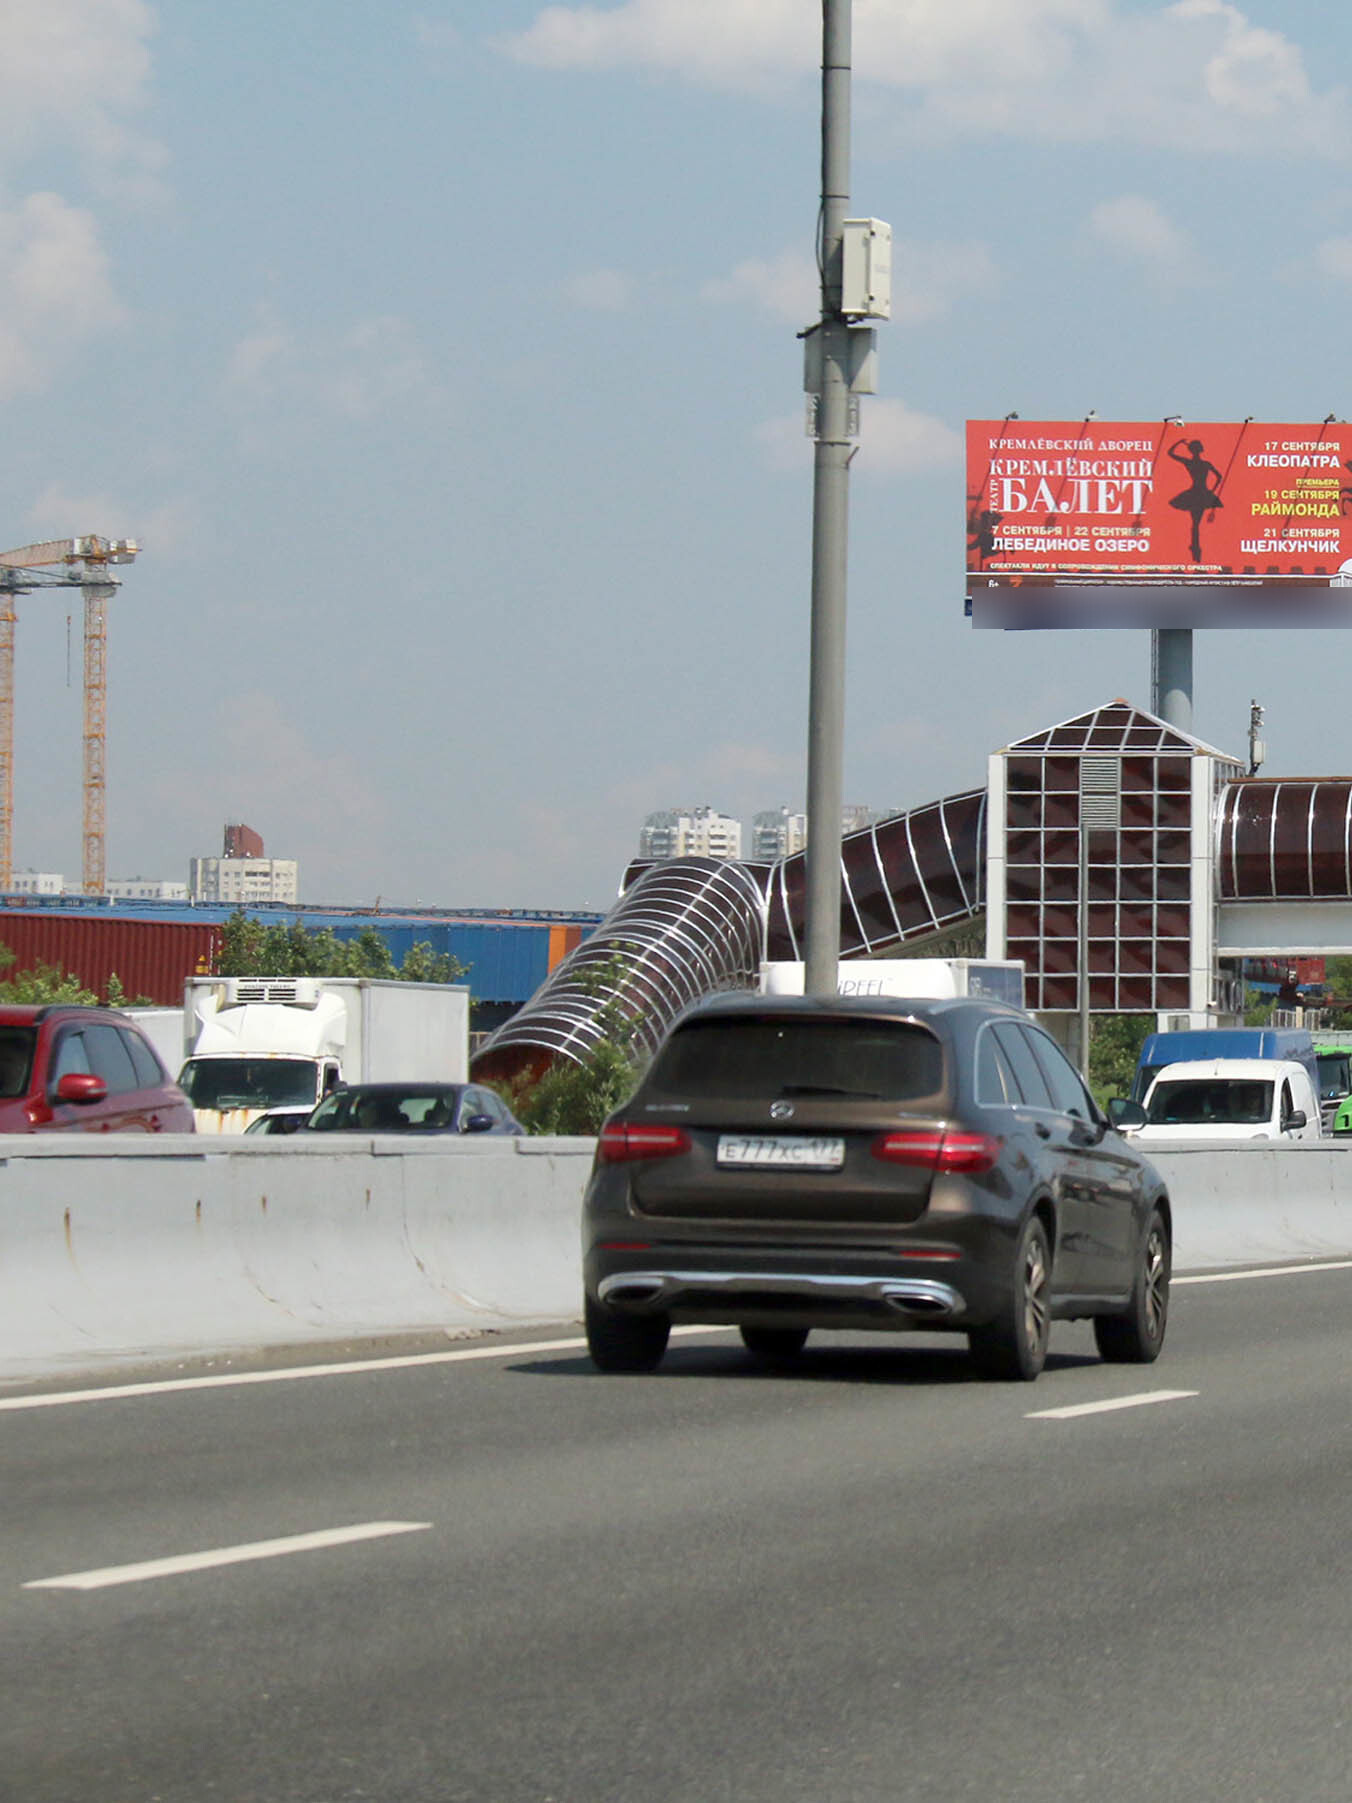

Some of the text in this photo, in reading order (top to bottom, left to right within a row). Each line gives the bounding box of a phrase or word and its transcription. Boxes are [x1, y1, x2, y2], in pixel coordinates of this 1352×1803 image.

[1098, 440, 1153, 451] ДВОРЕЦ
[1265, 442, 1340, 451] 17 СЕНТЯБРЯ
[989, 457, 1153, 477] КРЕМЛЁВСКИЙ
[1247, 455, 1340, 468] КЛЕОПАТРА
[1295, 478, 1340, 487] ПРЕМЬЕРА
[989, 479, 999, 513] ТЕАТР
[999, 477, 1153, 514] БАЛЕТ
[1264, 490, 1340, 500] 19 СЕНТЯБРЯ
[1251, 501, 1340, 518] РАЙМОНДА
[991, 525, 1151, 537] 7 СЕНТЯБРЯ 22 СЕНТЯБРЯ
[1264, 528, 1340, 538] 21 СЕНТЯБРЯ
[991, 538, 1150, 553] ЛЕБЕДИНОЕ ОЗЕРО
[1240, 540, 1340, 555] ЩЕЛКУНЧИК
